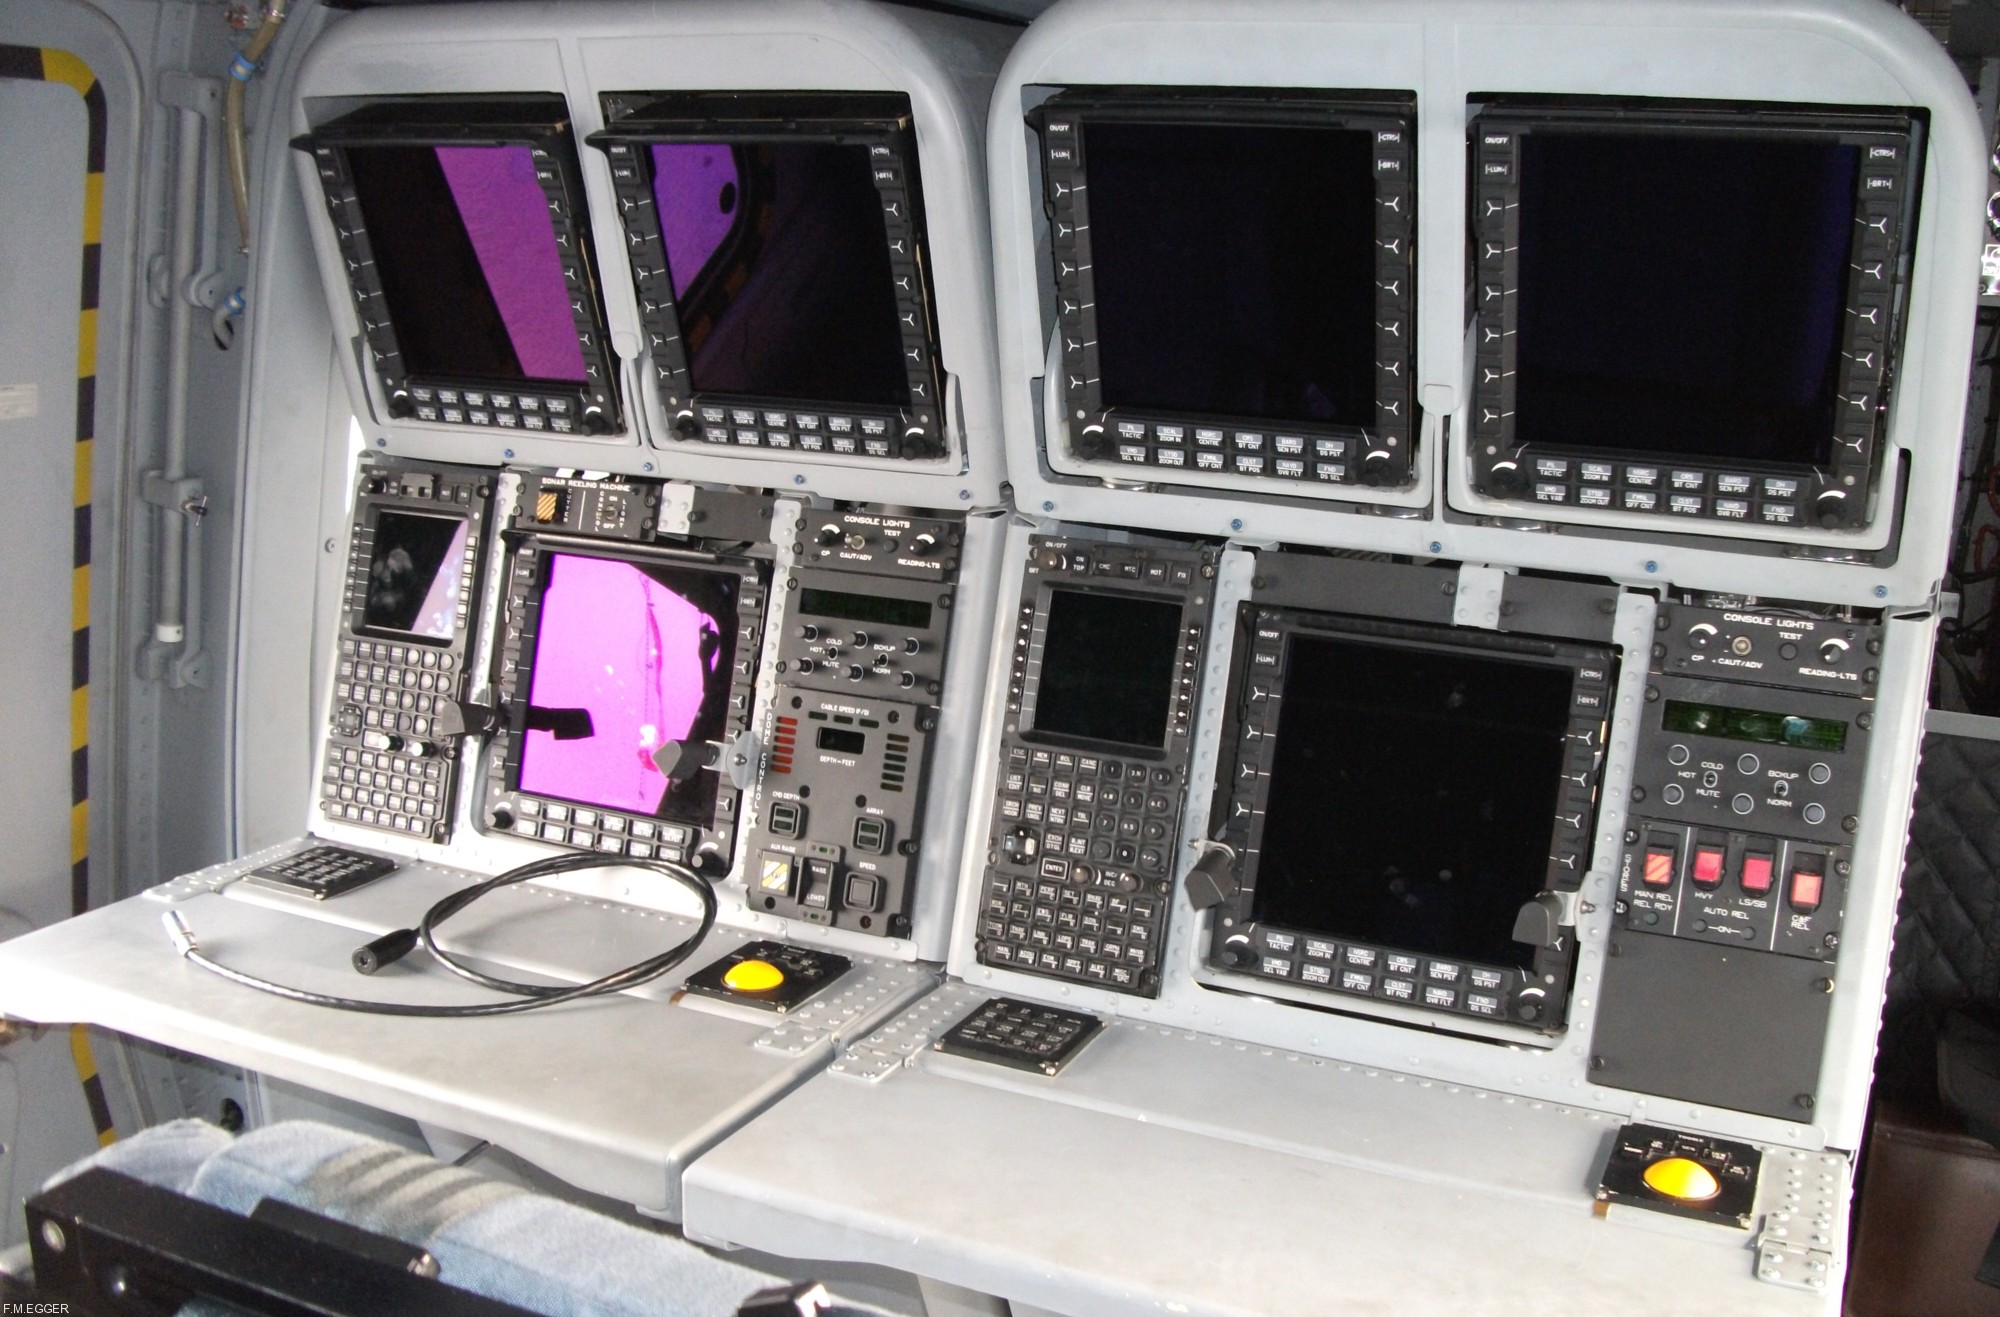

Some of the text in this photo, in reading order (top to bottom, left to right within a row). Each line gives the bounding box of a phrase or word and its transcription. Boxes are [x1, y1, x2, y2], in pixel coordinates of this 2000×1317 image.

[542, 478, 631, 492] SONAR REELING MACHINE
[844, 515, 910, 529] CONSOLE LIGHTS
[884, 529, 902, 538] TEST
[840, 552, 872, 562] CAUT/ADV
[1073, 564, 1085, 572] TOP
[1724, 612, 1814, 631] CONSOLE LIGHTS
[1778, 631, 1804, 641] TEST
[826, 638, 843, 646] COLD
[874, 644, 896, 652] BCKUP
[822, 660, 840, 668] MUTE
[1718, 658, 1764, 670] CAUT/ADV
[1798, 667, 1858, 681] READING-LTS
[820, 703, 838, 712] CABLE
[754, 712, 772, 808] DOME CONTROL
[1701, 761, 1724, 771] COLD
[1678, 771, 1697, 779] HOT
[1768, 770, 1799, 780] BCKUP
[783, 792, 800, 800] DEPTH
[1056, 790, 1066, 798] DEL
[1696, 788, 1721, 798] MUTE
[1766, 798, 1792, 808] NORM
[1052, 807, 1066, 815] NEXT
[782, 844, 796, 853] RAISE
[859, 861, 876, 870] SPEED
[1046, 864, 1064, 872] ENTER
[812, 866, 826, 875] RAISE
[1620, 854, 1632, 892] STORES
[807, 892, 826, 902] LOWER
[1634, 890, 1674, 902] MAN REL
[1695, 892, 1713, 900] HVY
[1634, 898, 1673, 912] REL RDY
[1704, 906, 1750, 920] AUTO REL
[1718, 926, 1732, 934] ON
[1792, 922, 1810, 931] REL
